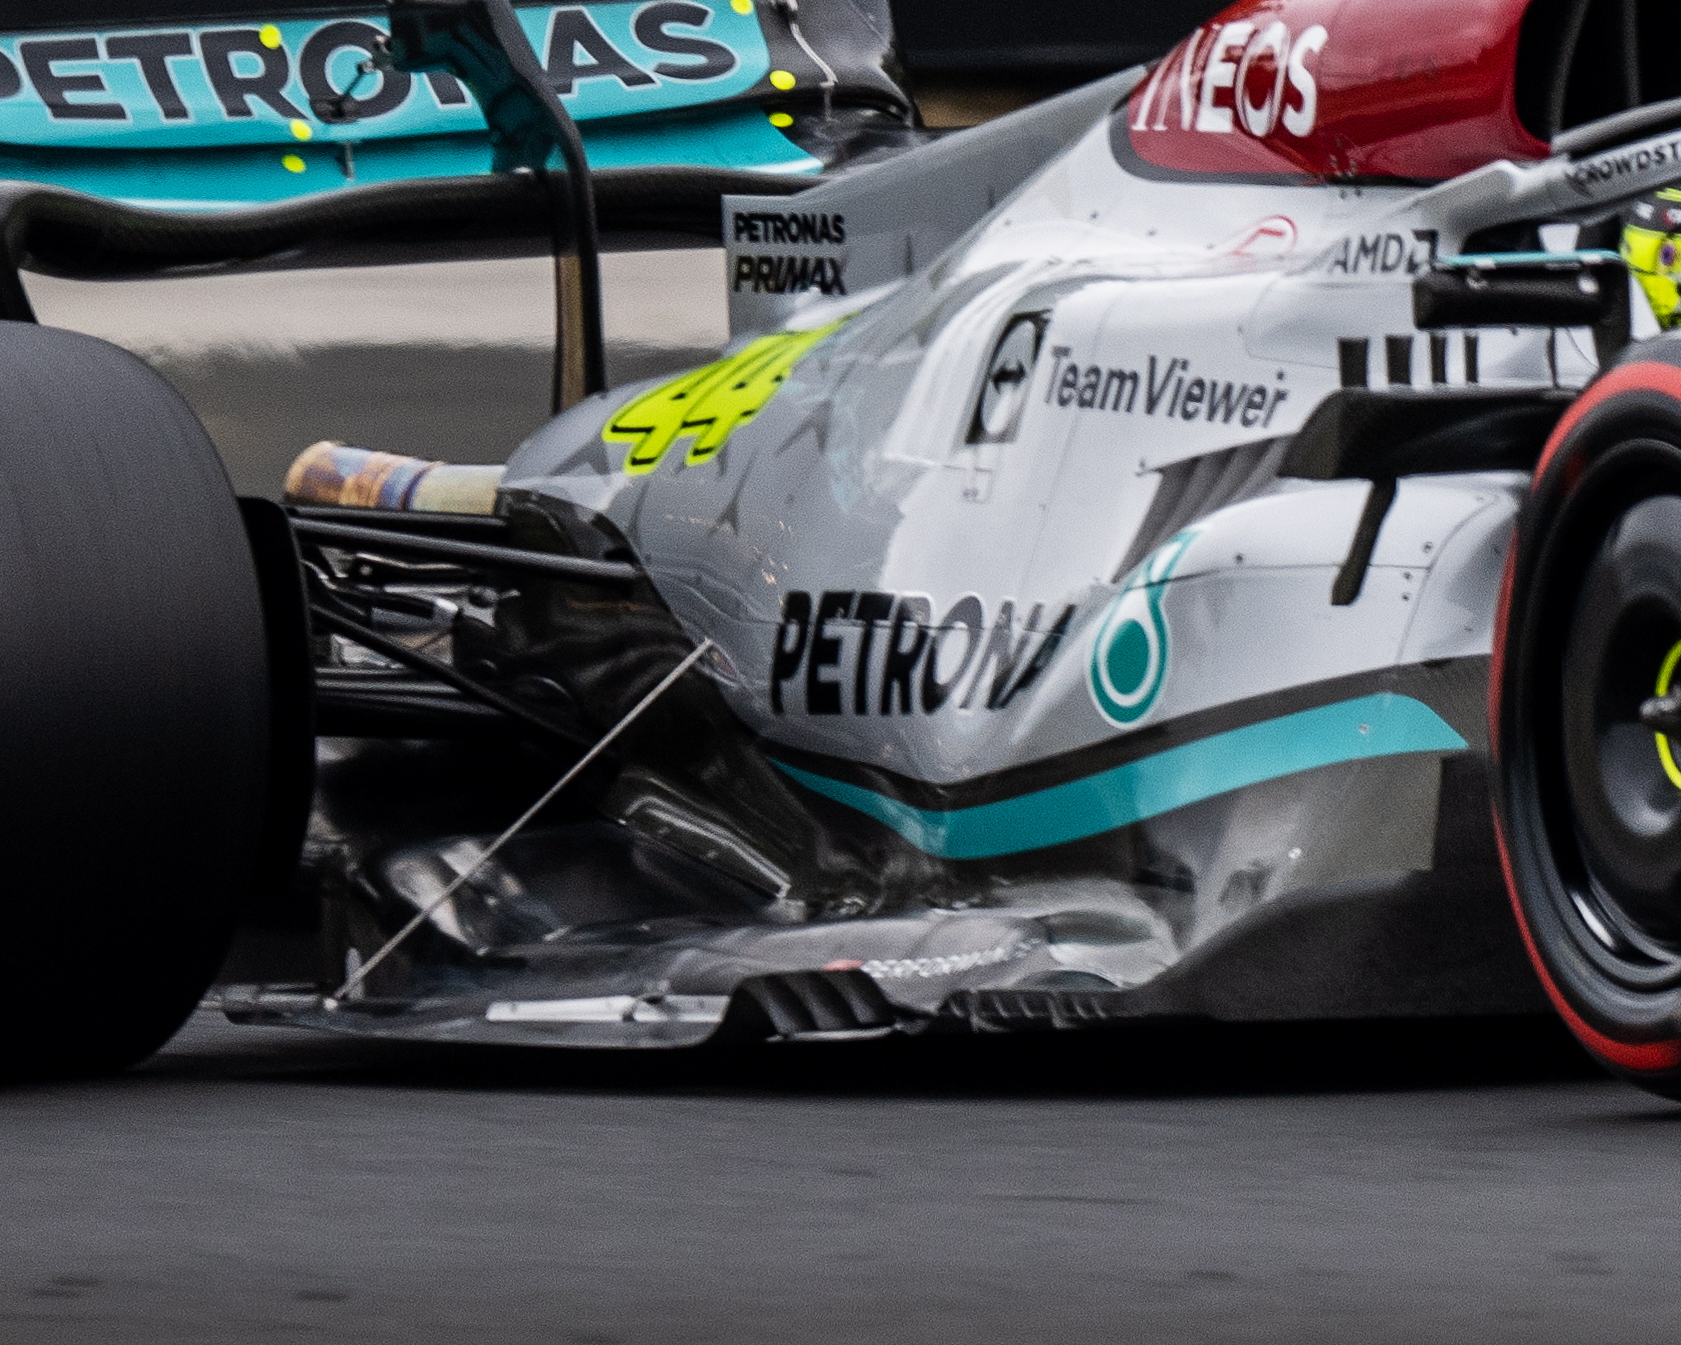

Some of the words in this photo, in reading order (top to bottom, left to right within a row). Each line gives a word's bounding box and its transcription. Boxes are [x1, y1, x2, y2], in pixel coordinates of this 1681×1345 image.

[1131, 19, 1329, 138] INEOS
[733, 212, 847, 244] PETRONAS
[1327, 233, 1404, 274] AMD
[733, 256, 847, 295] PRIMAX
[1043, 346, 1288, 428] TeamViewer
[770, 590, 1077, 716] PETRON
